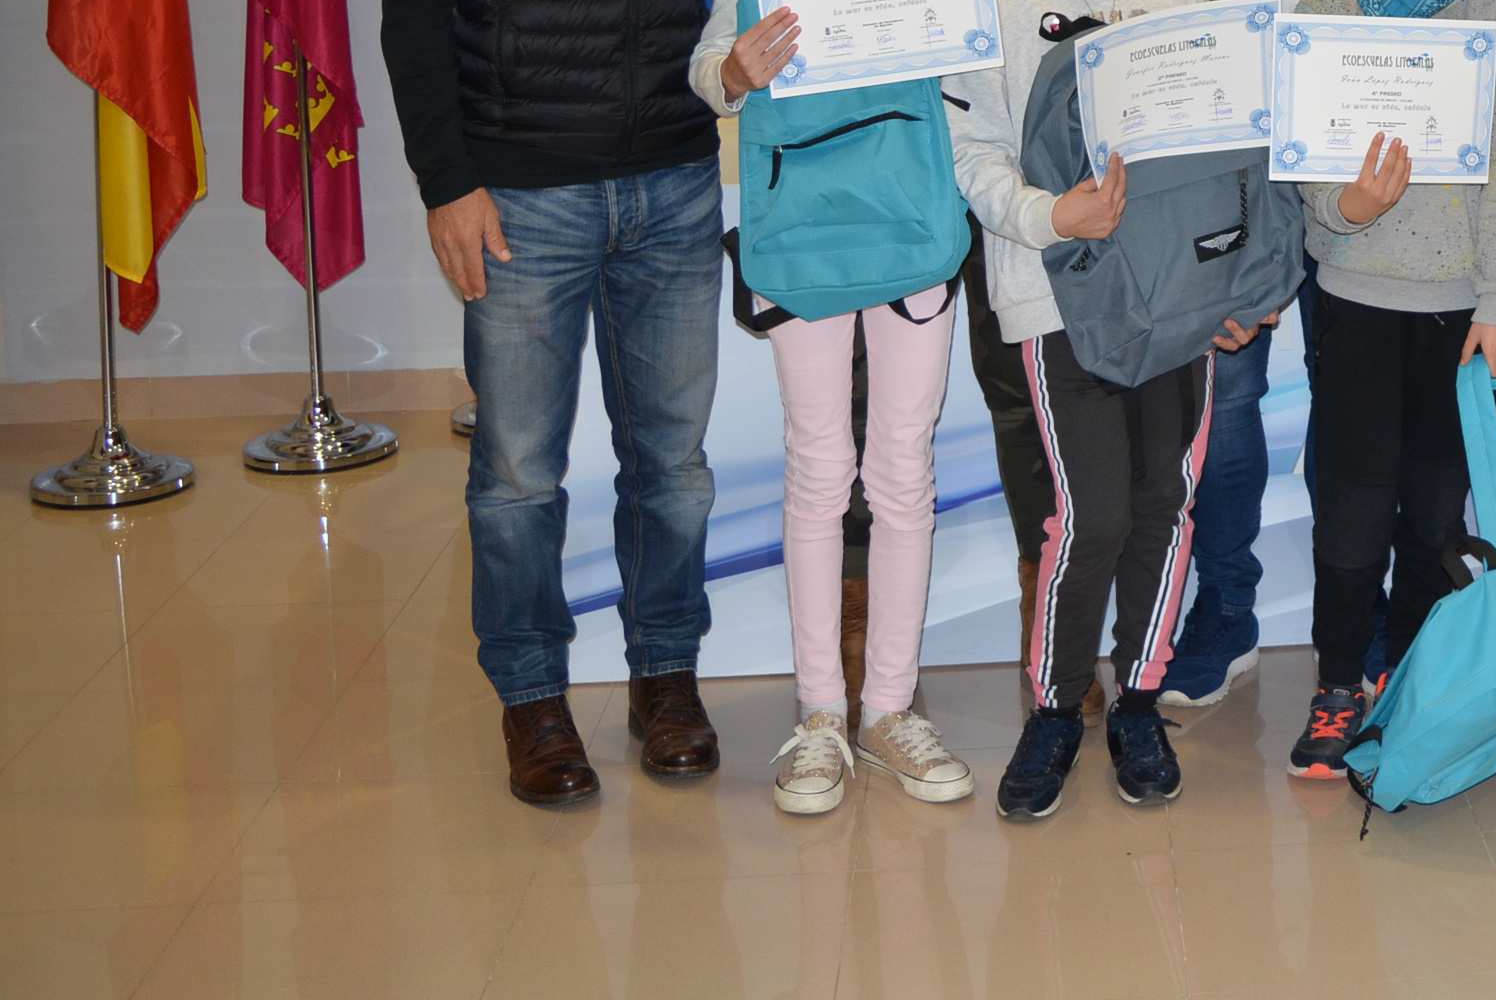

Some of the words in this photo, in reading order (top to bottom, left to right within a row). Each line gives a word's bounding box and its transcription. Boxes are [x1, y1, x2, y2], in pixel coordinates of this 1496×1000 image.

[1130, 42, 1177, 62] ECOESCUELAS
[1342, 54, 1393, 68] ECOESCUELAS
[1165, 71, 1187, 79] PREMIO
